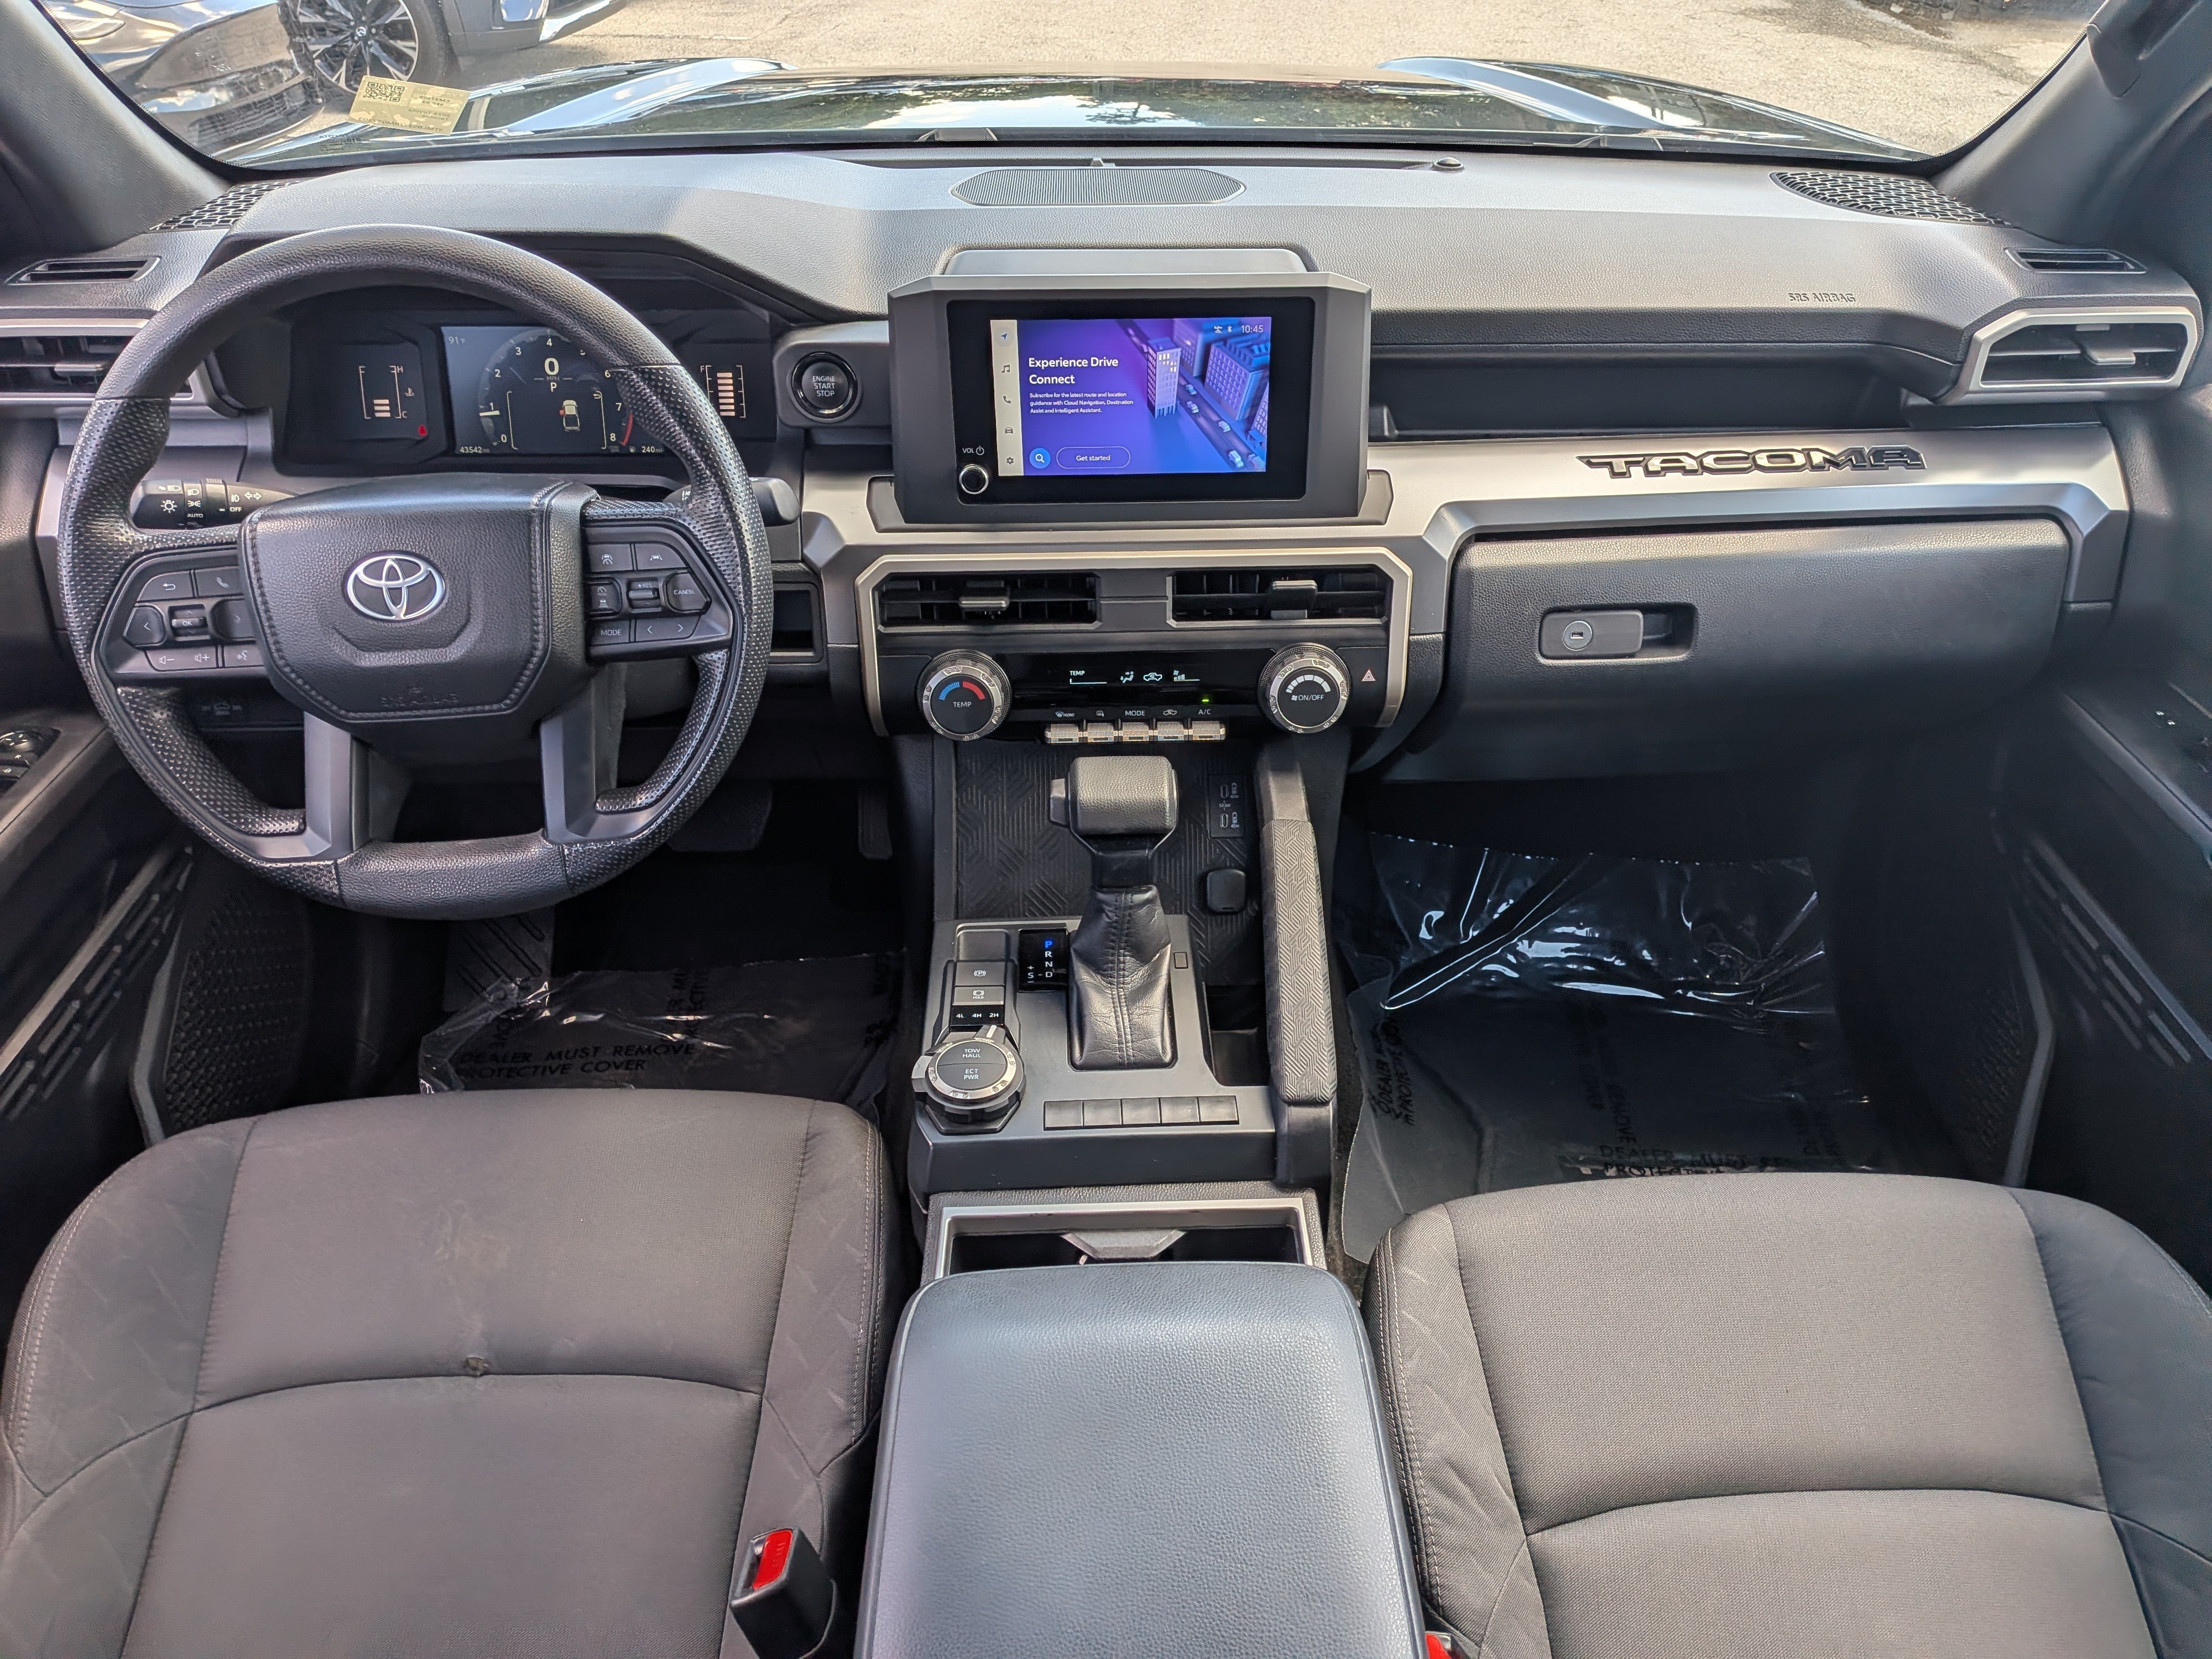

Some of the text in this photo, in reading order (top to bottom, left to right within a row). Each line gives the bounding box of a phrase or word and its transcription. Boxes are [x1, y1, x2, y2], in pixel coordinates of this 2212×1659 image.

[1788, 293, 1856, 302] SRS AIRBAG
[1241, 325, 1264, 333] 10:45
[515, 347, 521, 356] 3
[544, 358, 559, 375] 0
[1029, 357, 1119, 369] Experience Drive
[494, 369, 501, 378] 2
[604, 369, 611, 378] 6
[1029, 374, 1076, 384] Connect
[550, 382, 557, 392] P
[489, 402, 494, 411] 1
[615, 403, 622, 411] 7
[500, 434, 507, 442] 0
[610, 433, 616, 441] 8
[1575, 444, 1928, 479] TACOMA
[545, 1046, 603, 1061] MUST
[612, 1043, 697, 1057] REMOVE
[580, 1059, 646, 1074] COVER
